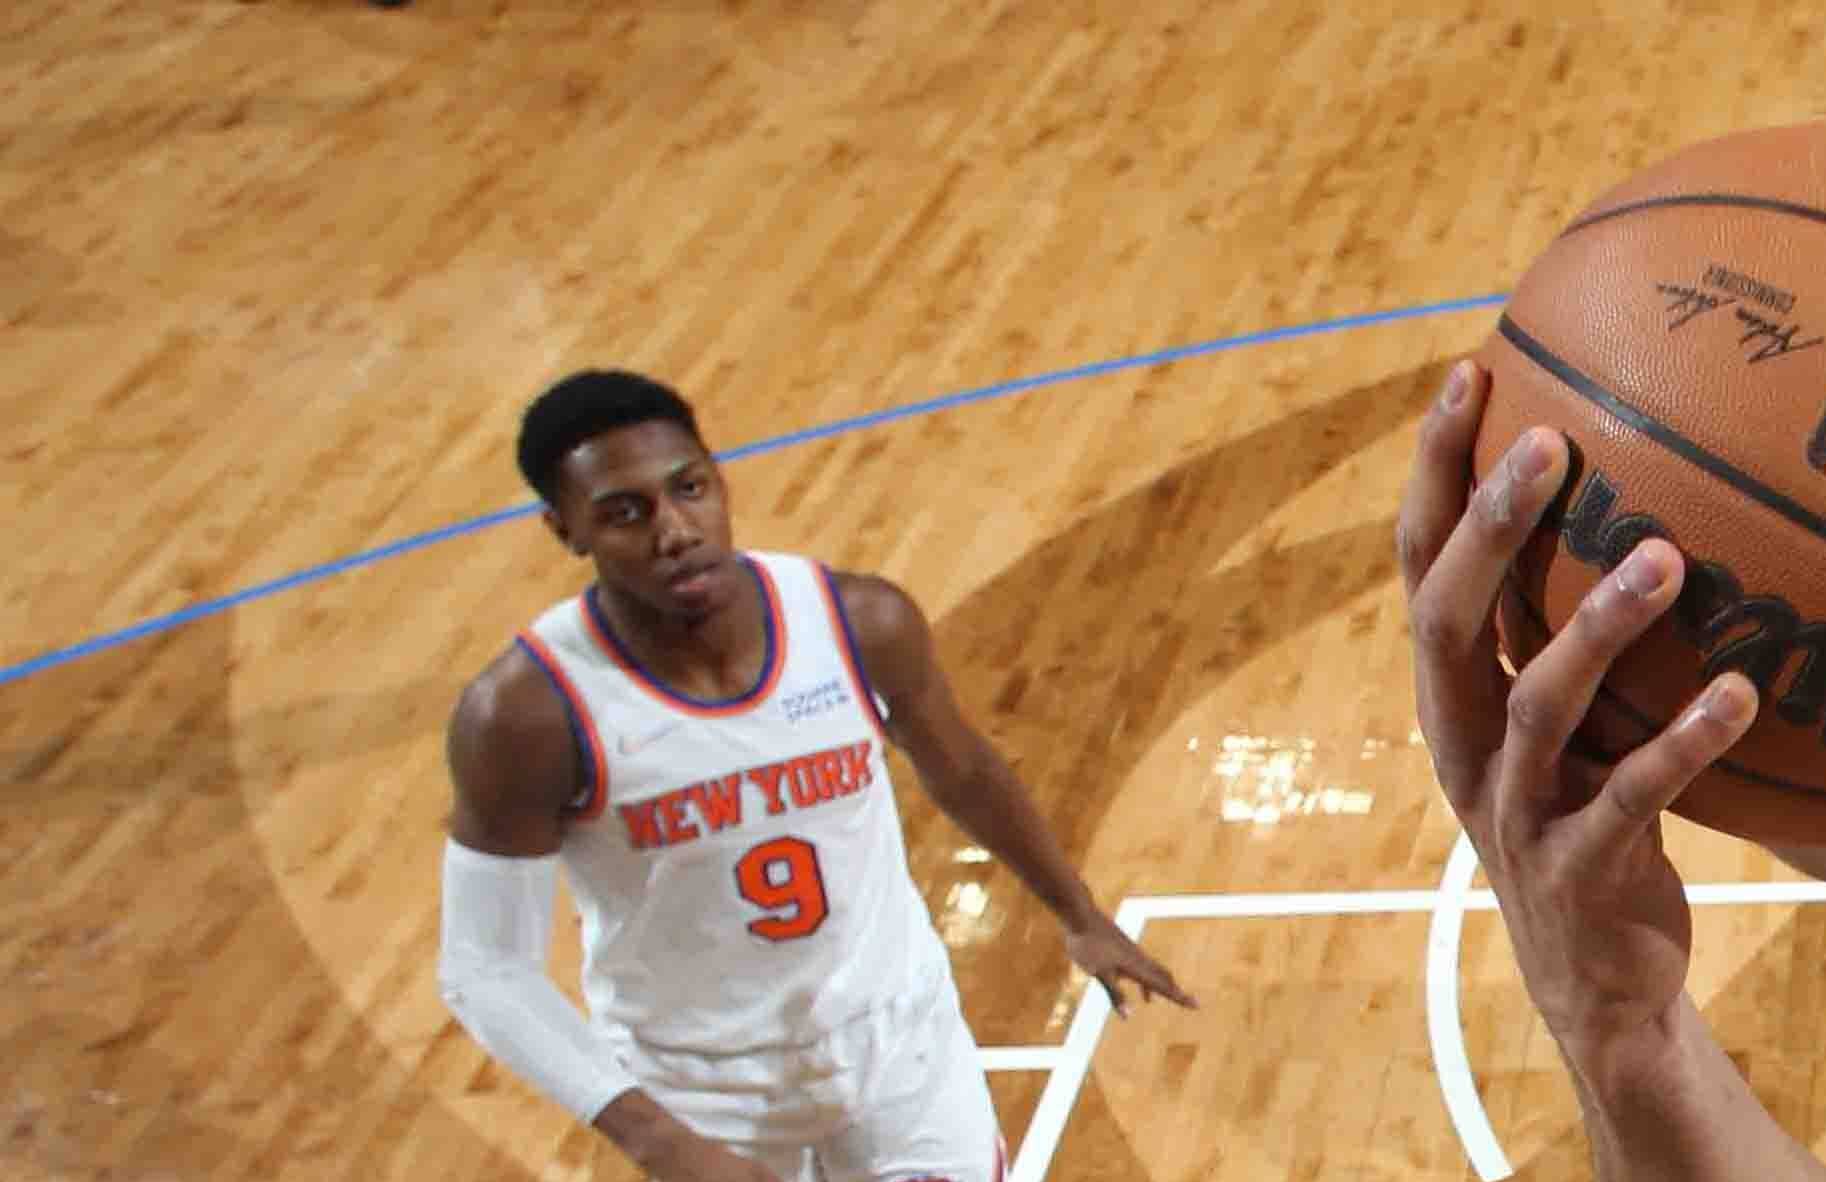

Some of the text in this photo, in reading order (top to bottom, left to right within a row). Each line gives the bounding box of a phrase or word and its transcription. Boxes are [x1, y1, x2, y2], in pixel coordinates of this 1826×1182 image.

[617, 740, 873, 850] NEW YORK
[735, 836, 829, 941] 9
